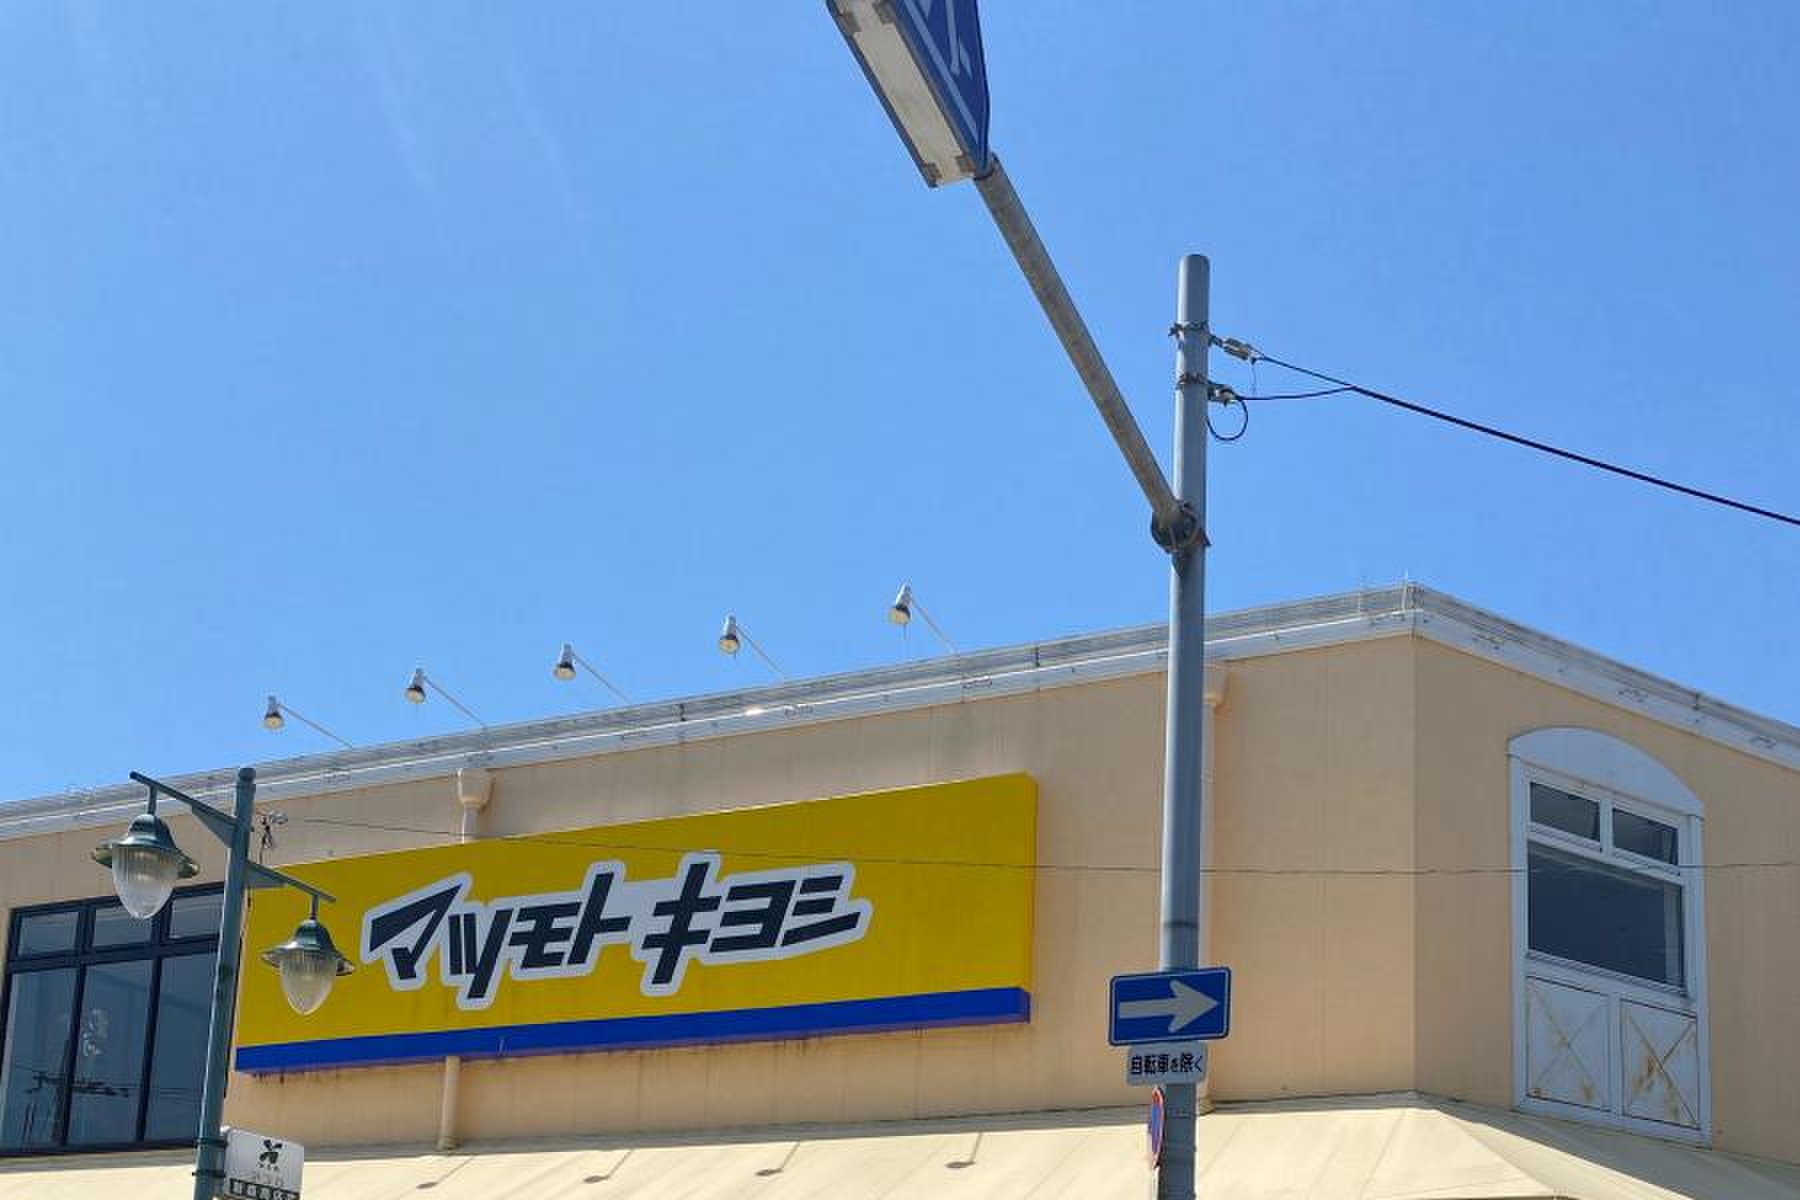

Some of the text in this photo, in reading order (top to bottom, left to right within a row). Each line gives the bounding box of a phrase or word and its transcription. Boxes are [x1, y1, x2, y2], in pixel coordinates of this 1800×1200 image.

[368, 861, 862, 999] マツモトキヨシ
[1131, 1052, 1203, 1075] 自転車を除く
